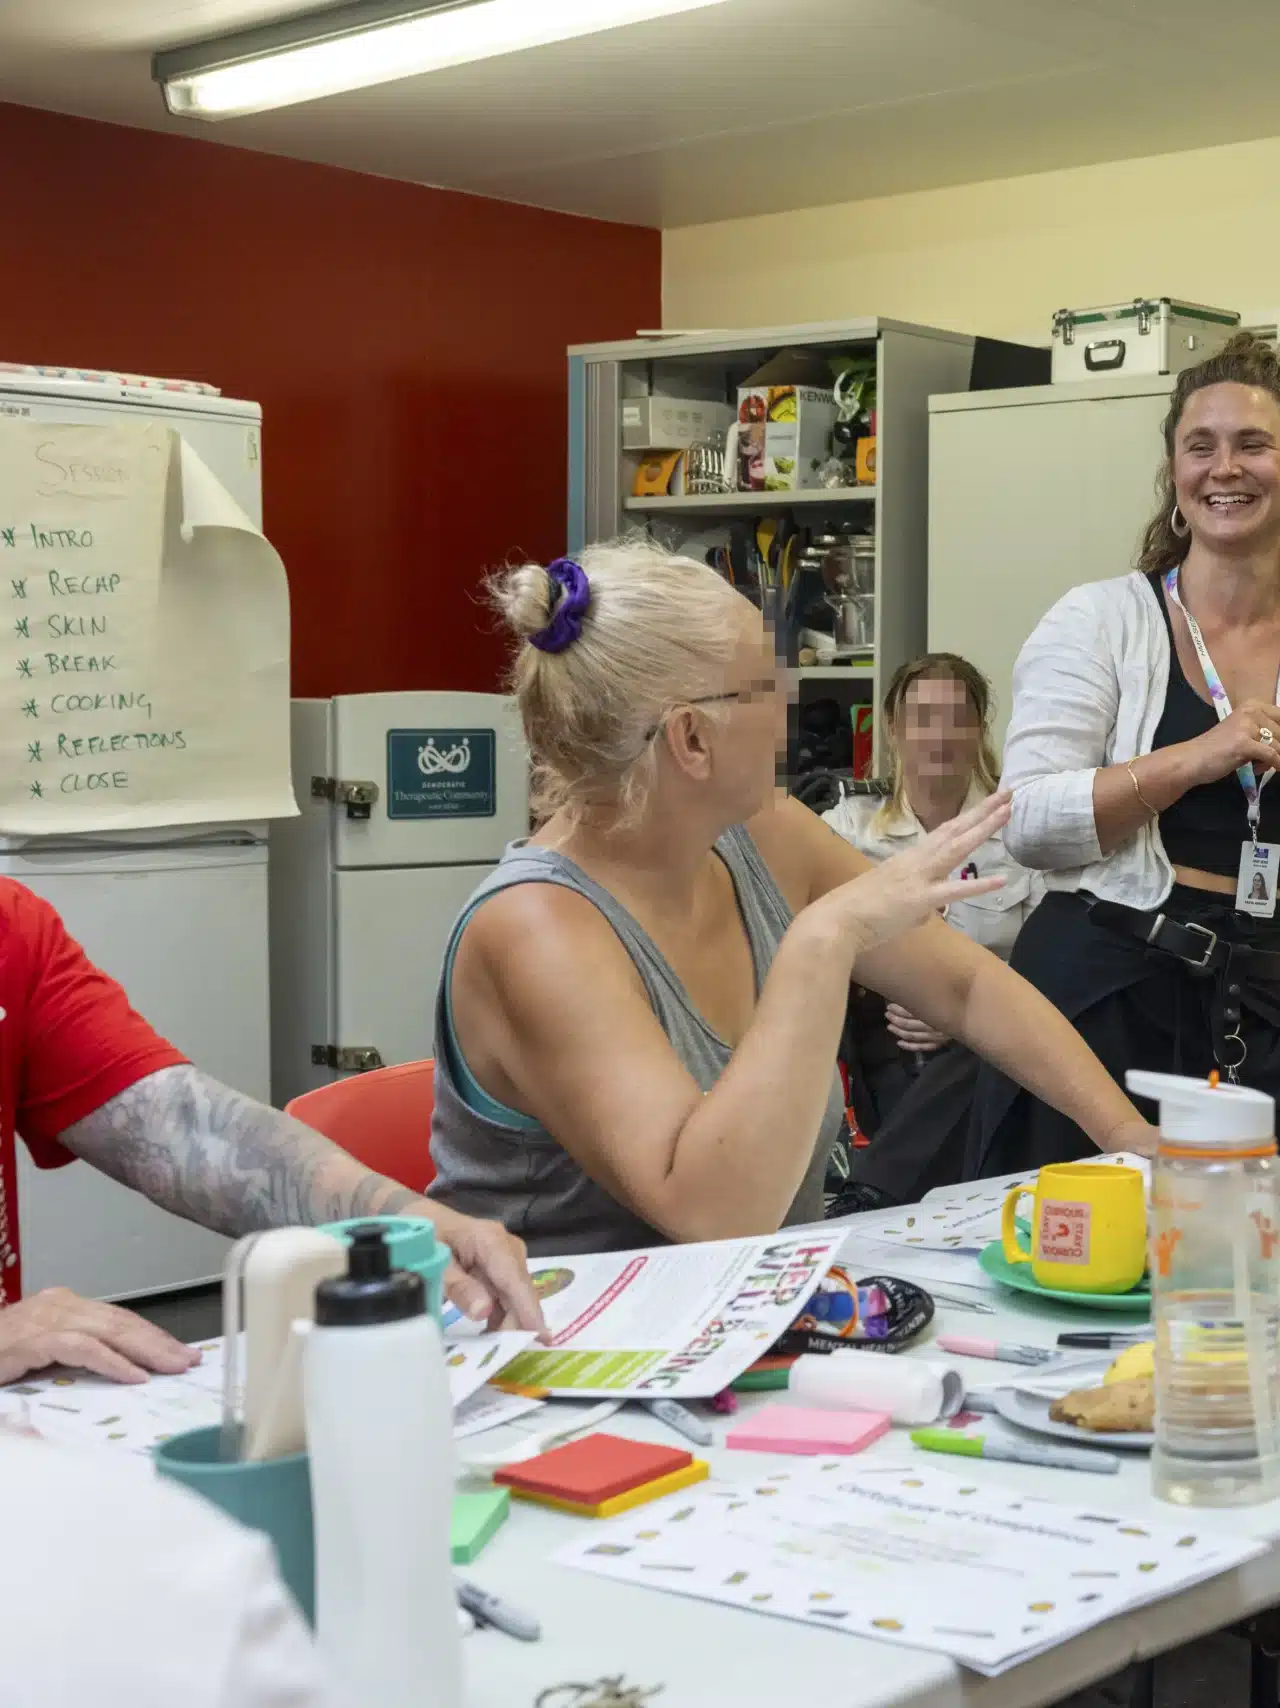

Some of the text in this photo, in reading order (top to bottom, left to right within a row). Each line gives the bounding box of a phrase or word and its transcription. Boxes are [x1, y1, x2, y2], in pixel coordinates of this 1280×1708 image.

[31, 523, 94, 549] INTRO
[49, 569, 121, 596] RECAP
[47, 615, 108, 639] SKIN
[44, 652, 118, 674] BREAK
[51, 692, 152, 719] COOKING
[57, 730, 188, 759] REFLECTIONS
[60, 771, 129, 794] CLOSE
